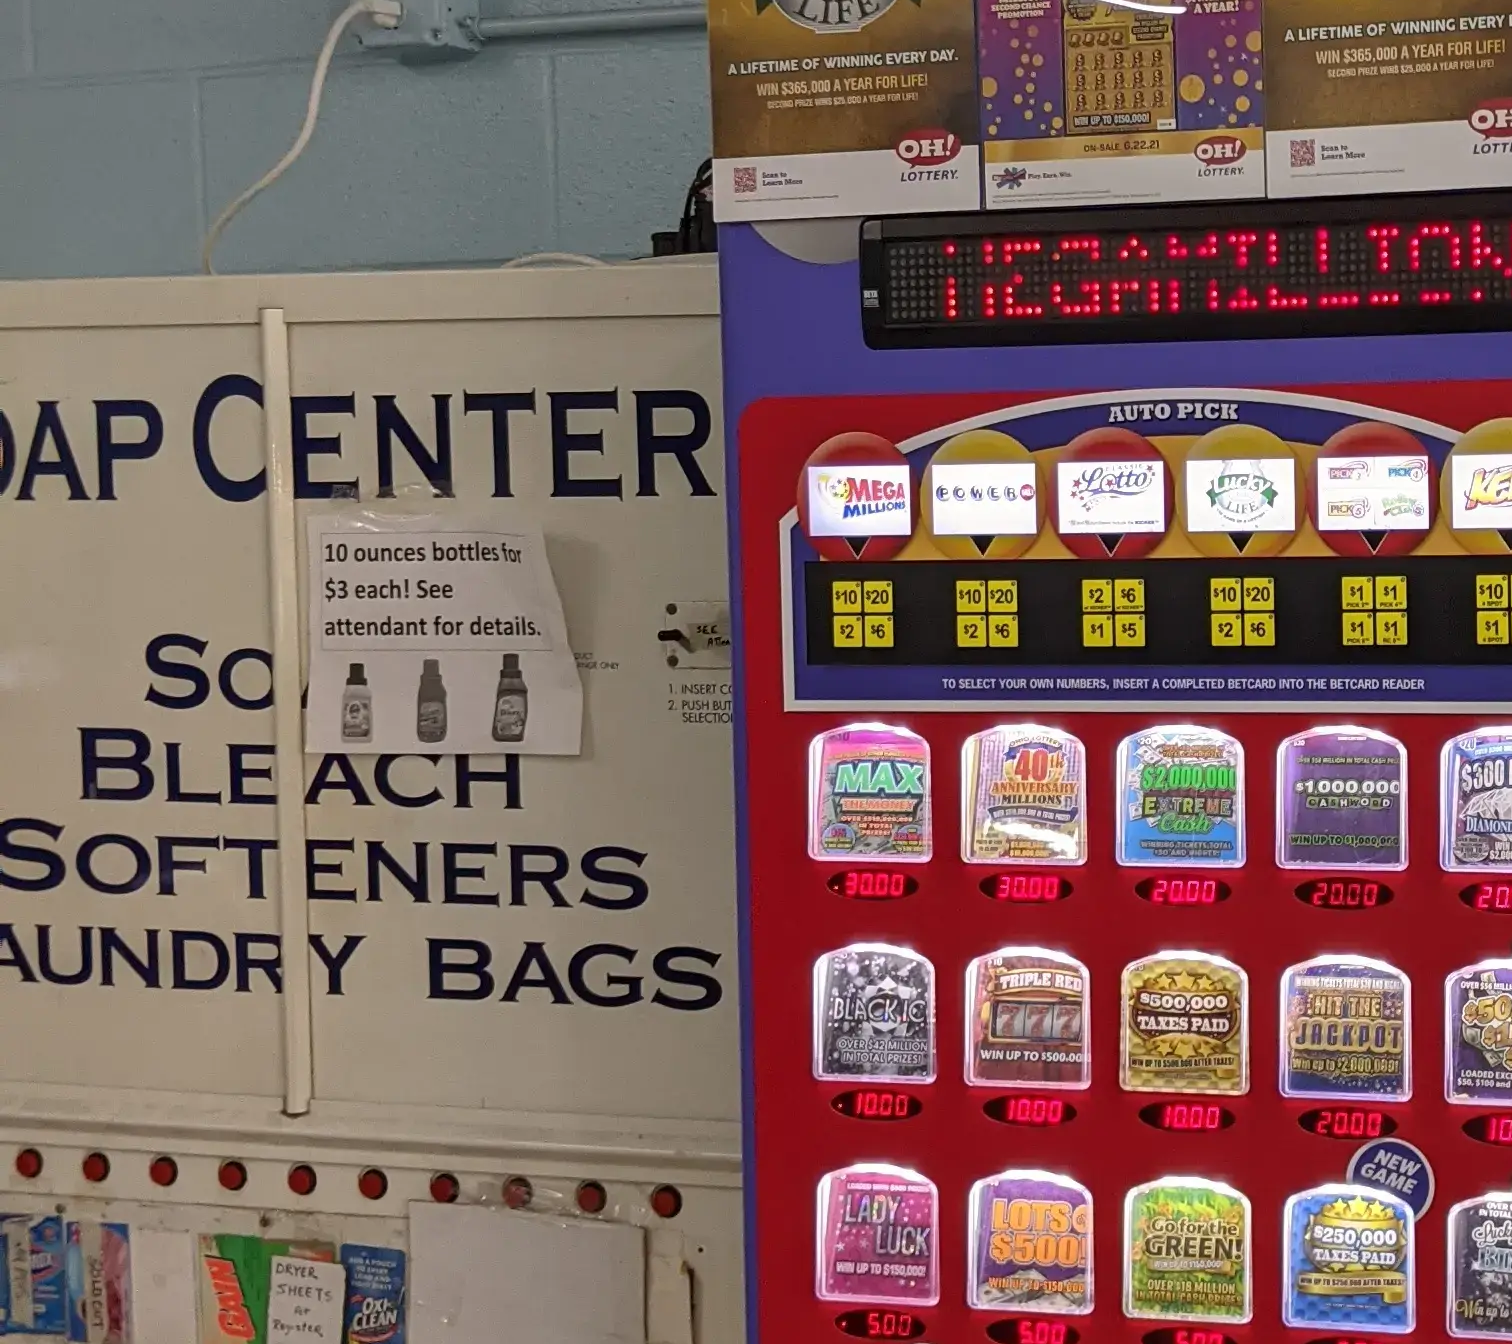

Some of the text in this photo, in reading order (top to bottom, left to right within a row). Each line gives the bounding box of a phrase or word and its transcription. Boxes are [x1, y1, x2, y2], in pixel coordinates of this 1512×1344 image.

[1284, 29, 1295, 42] A
[1298, 24, 1362, 41] LIFETIME
[1367, 23, 1386, 36] OF
[1391, 18, 1456, 35] WINNING
[1460, 15, 1505, 30] EVERY
[1108, 403, 1239, 423] AUTO PICK
[0, 374, 718, 504] AP CENTER
[847, 477, 905, 502] MEGA
[842, 501, 906, 519] MILLIONS
[324, 540, 522, 565] 10 ounces bottles for
[324, 578, 454, 602] $3 each! See
[835, 589, 889, 606] $10 $20
[324, 615, 542, 637] attendant for details.
[942, 679, 1424, 691] TO SELECT YOUR OWN NUMBERS, INSERT A COMPLETED BETCARD INTO THE BETCARD READER
[78, 726, 524, 810] BLEACH
[835, 761, 924, 796] MAX
[0, 817, 650, 911] SOFTENERS
[426, 937, 723, 1011] BAGS
[1138, 1015, 1229, 1032] TAXES PAID
[276, 1263, 318, 1280] DRYER
[277, 1284, 333, 1302] SHEETS
[352, 1310, 397, 1330] CLEAN
